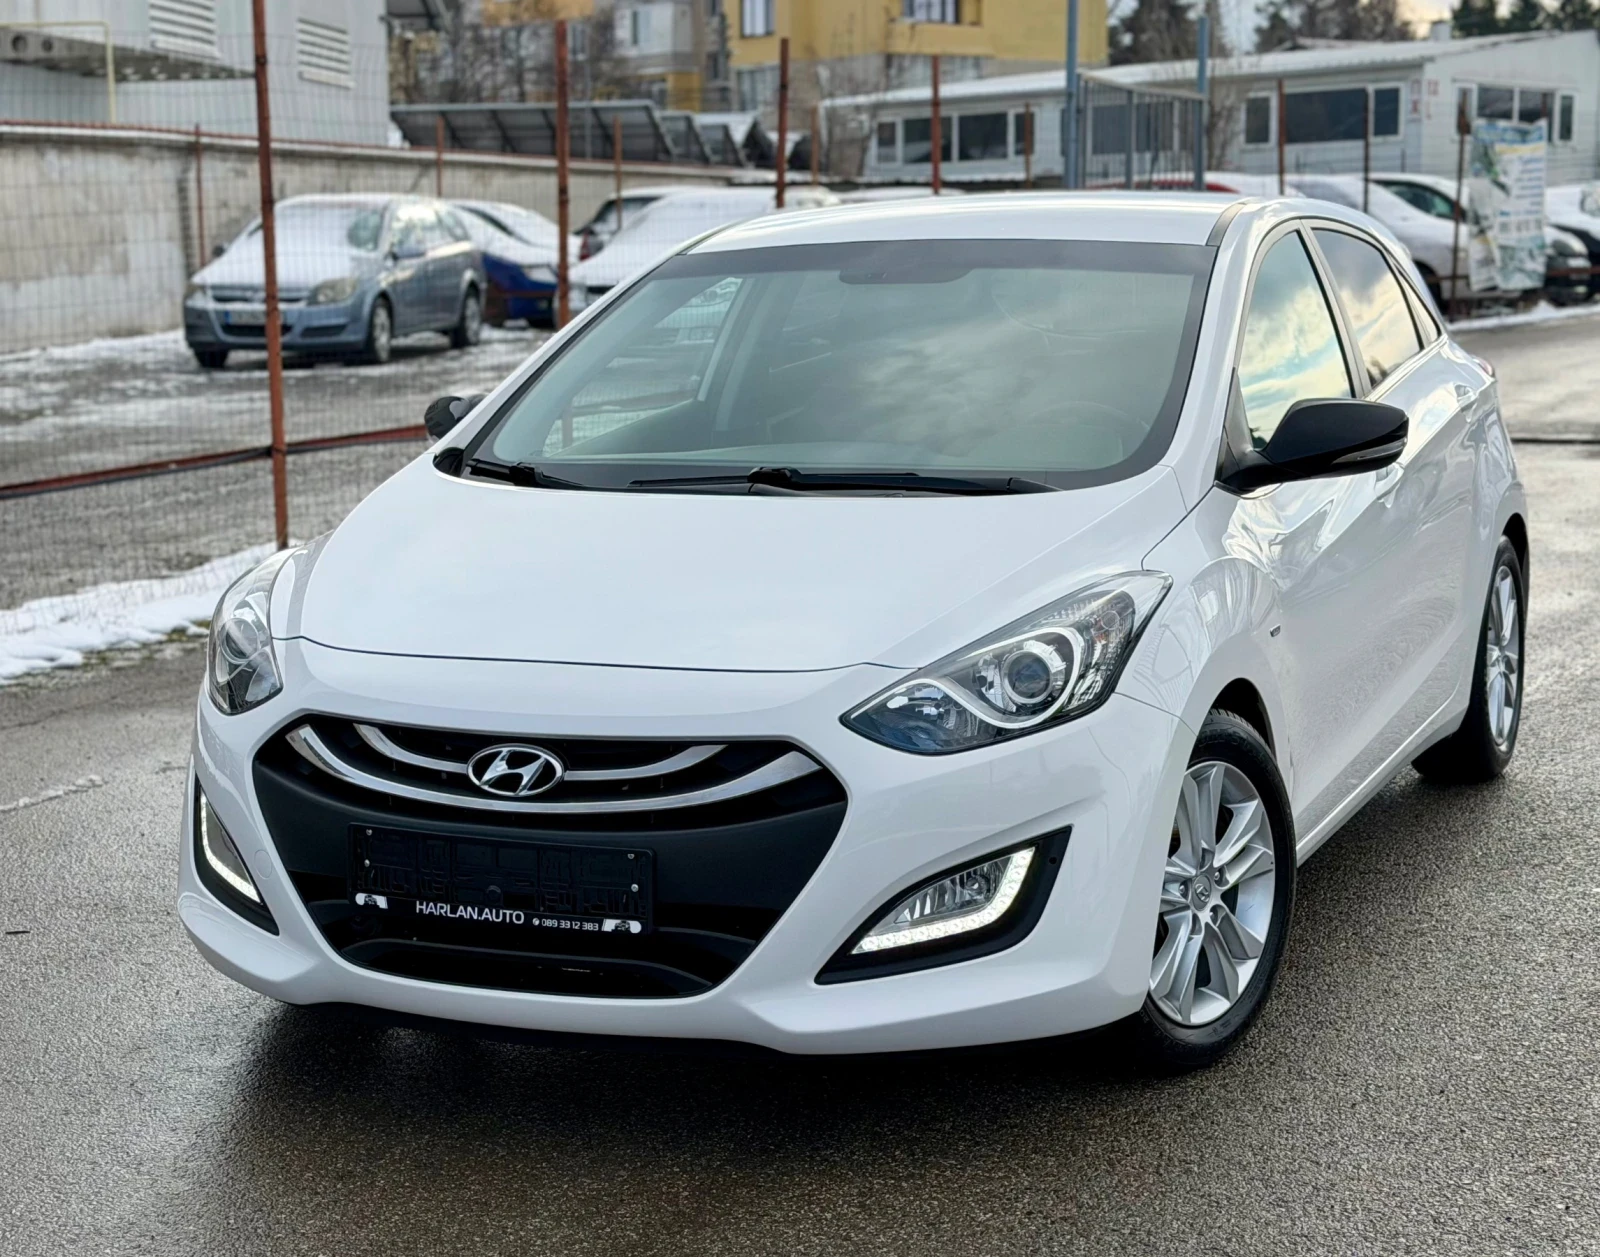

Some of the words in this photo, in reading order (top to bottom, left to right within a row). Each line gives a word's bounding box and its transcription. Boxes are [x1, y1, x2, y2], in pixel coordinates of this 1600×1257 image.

[416, 900, 524, 924] HARLAN.AUTO
[541, 918, 558, 928] 089
[559, 920, 570, 929] 33
[572, 921, 581, 930] 12
[582, 922, 599, 931] 383
